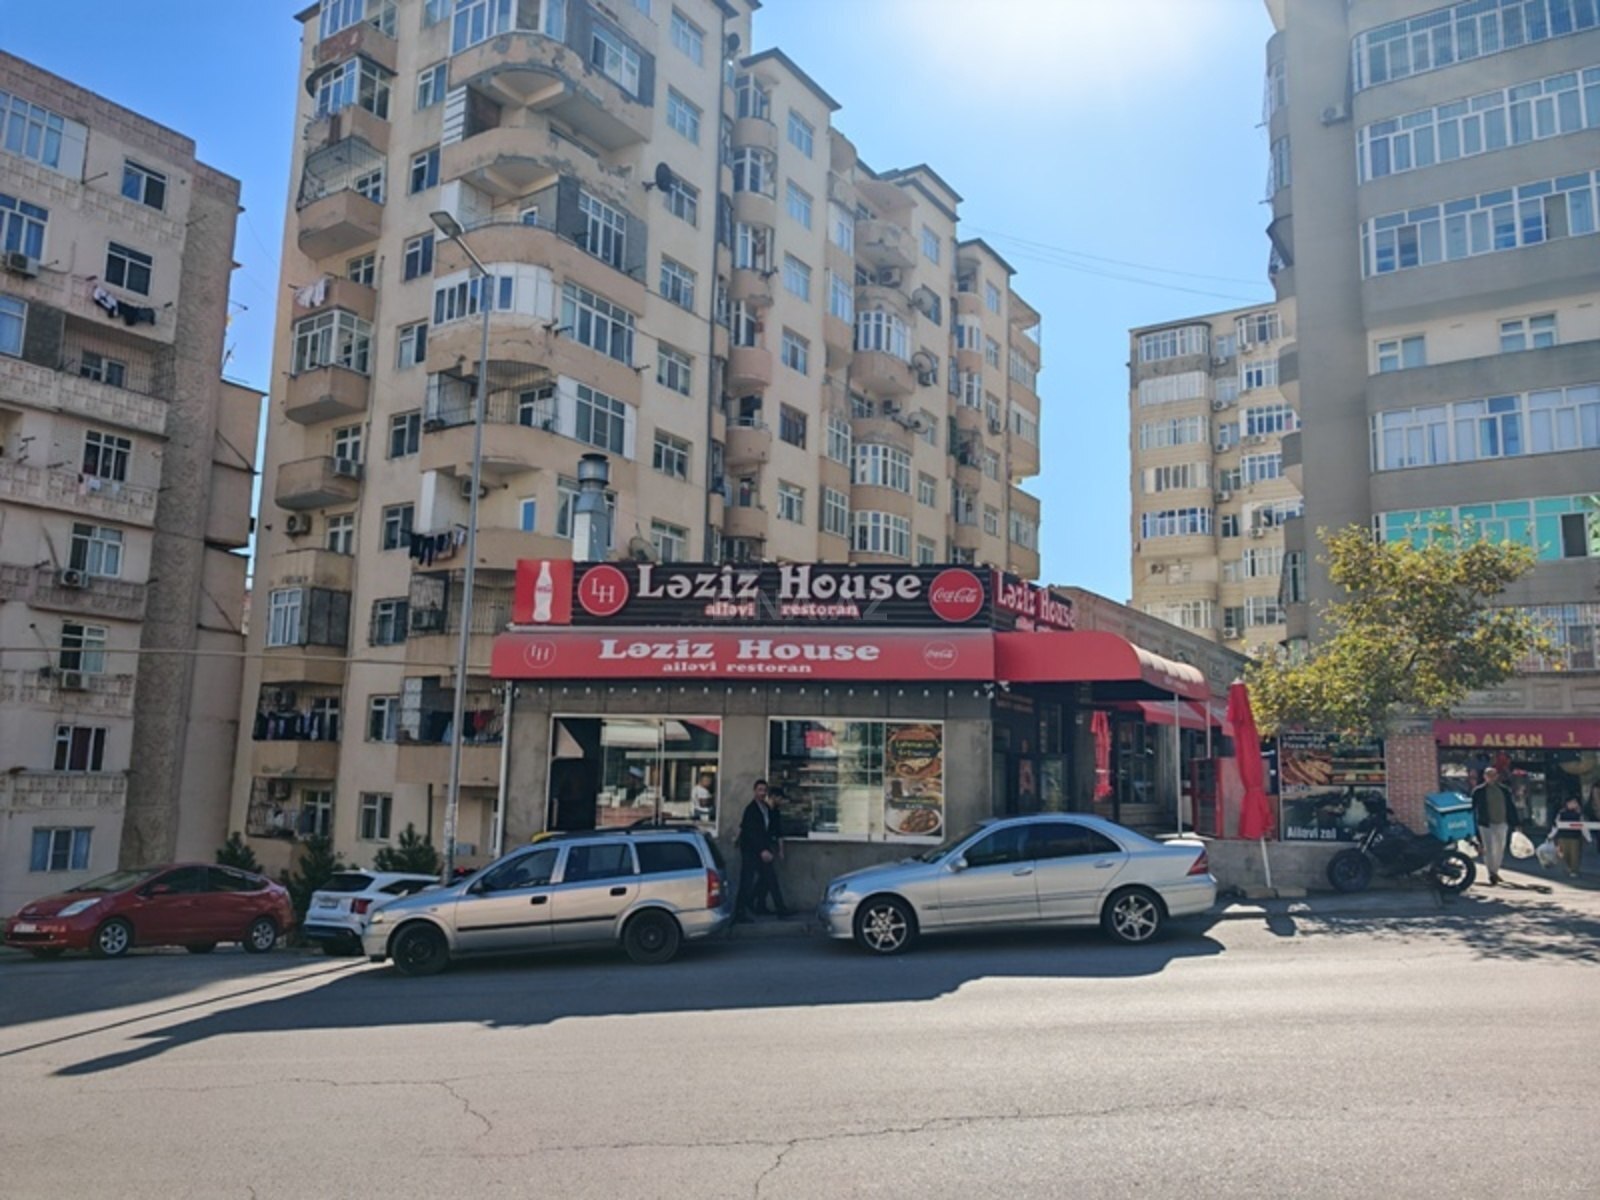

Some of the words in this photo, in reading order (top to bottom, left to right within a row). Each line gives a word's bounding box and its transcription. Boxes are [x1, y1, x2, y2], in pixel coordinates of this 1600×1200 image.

[591, 577, 615, 603] LH
[637, 565, 760, 599] Ləziz
[778, 565, 921, 599] House
[780, 601, 860, 617] restoran
[598, 638, 715, 660] Ləziz
[736, 639, 880, 661] House
[662, 661, 717, 672] ailəvi
[726, 662, 812, 673] restoran
[1449, 732, 1477, 747] NƏ
[1482, 733, 1544, 747] ALSAN
